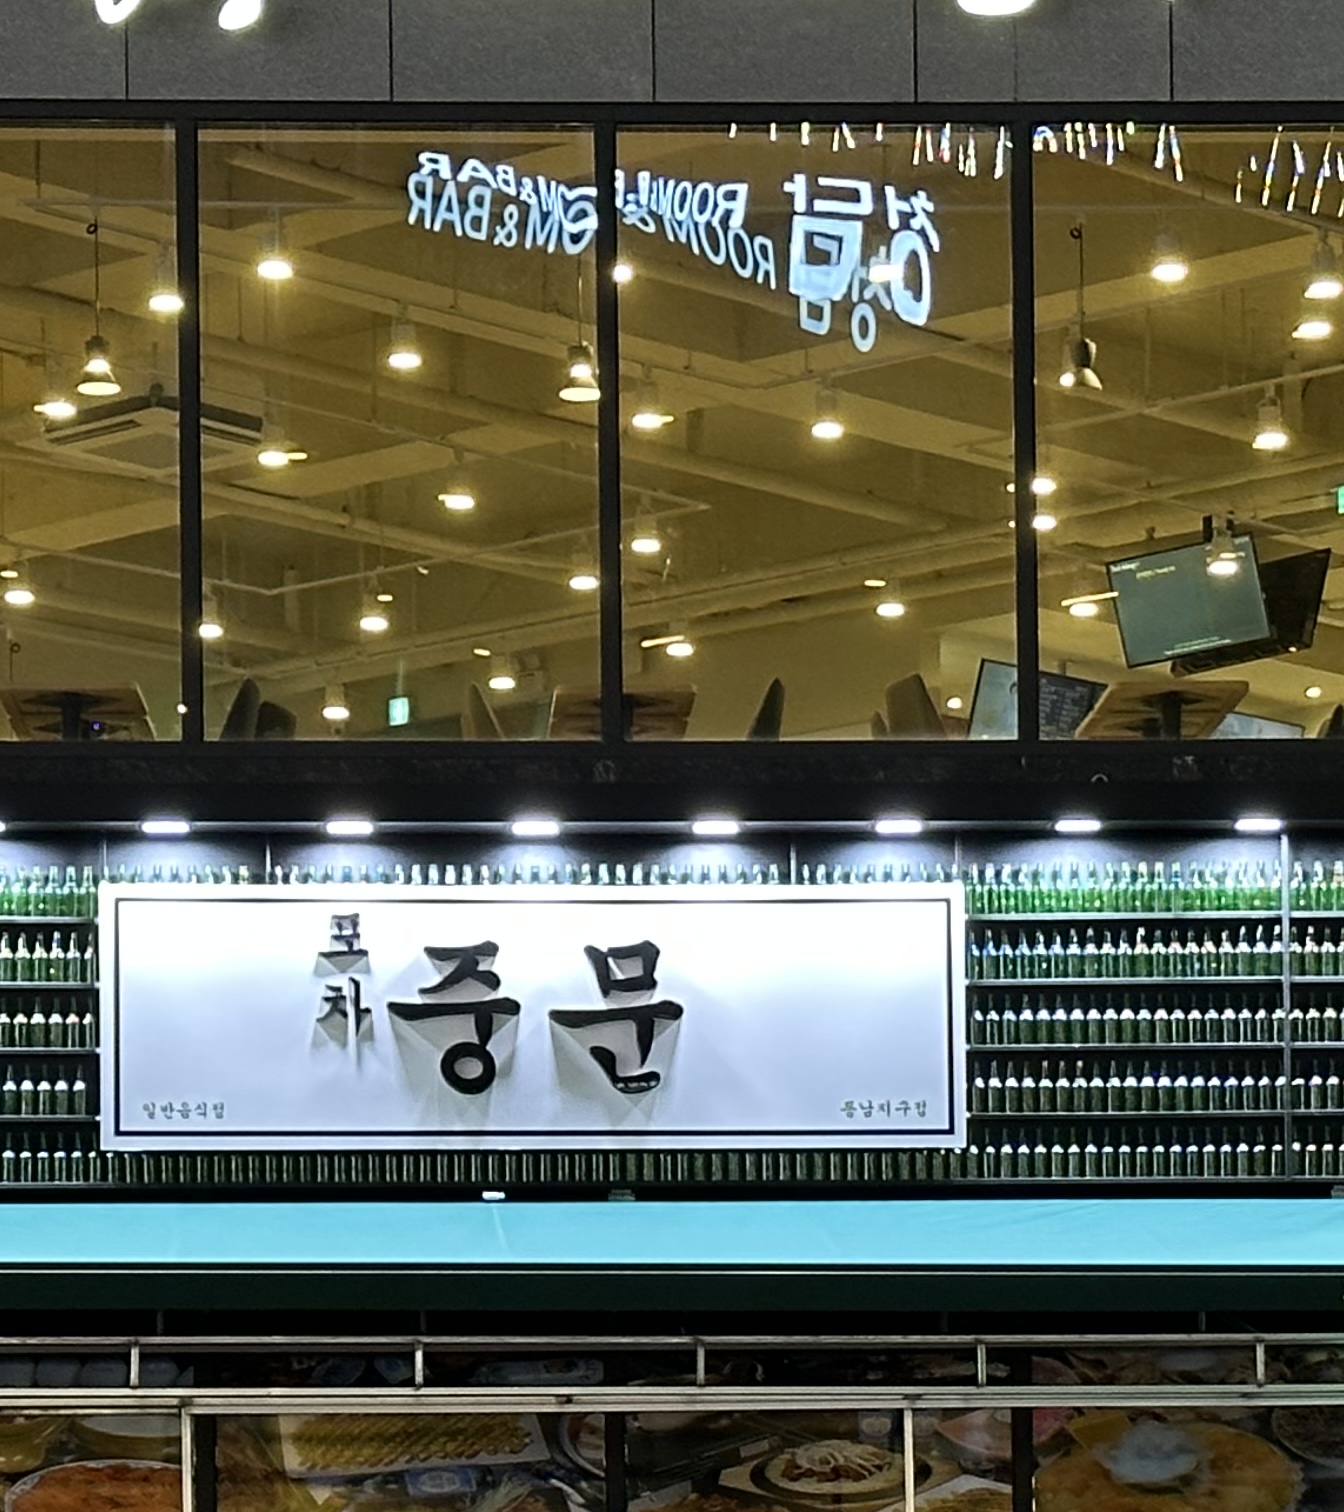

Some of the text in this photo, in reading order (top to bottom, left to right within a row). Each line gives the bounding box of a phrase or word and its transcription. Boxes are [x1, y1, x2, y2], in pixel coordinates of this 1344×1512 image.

[316, 912, 684, 1096] 포차 중문
[142, 1101, 225, 1120] 일반음식점
